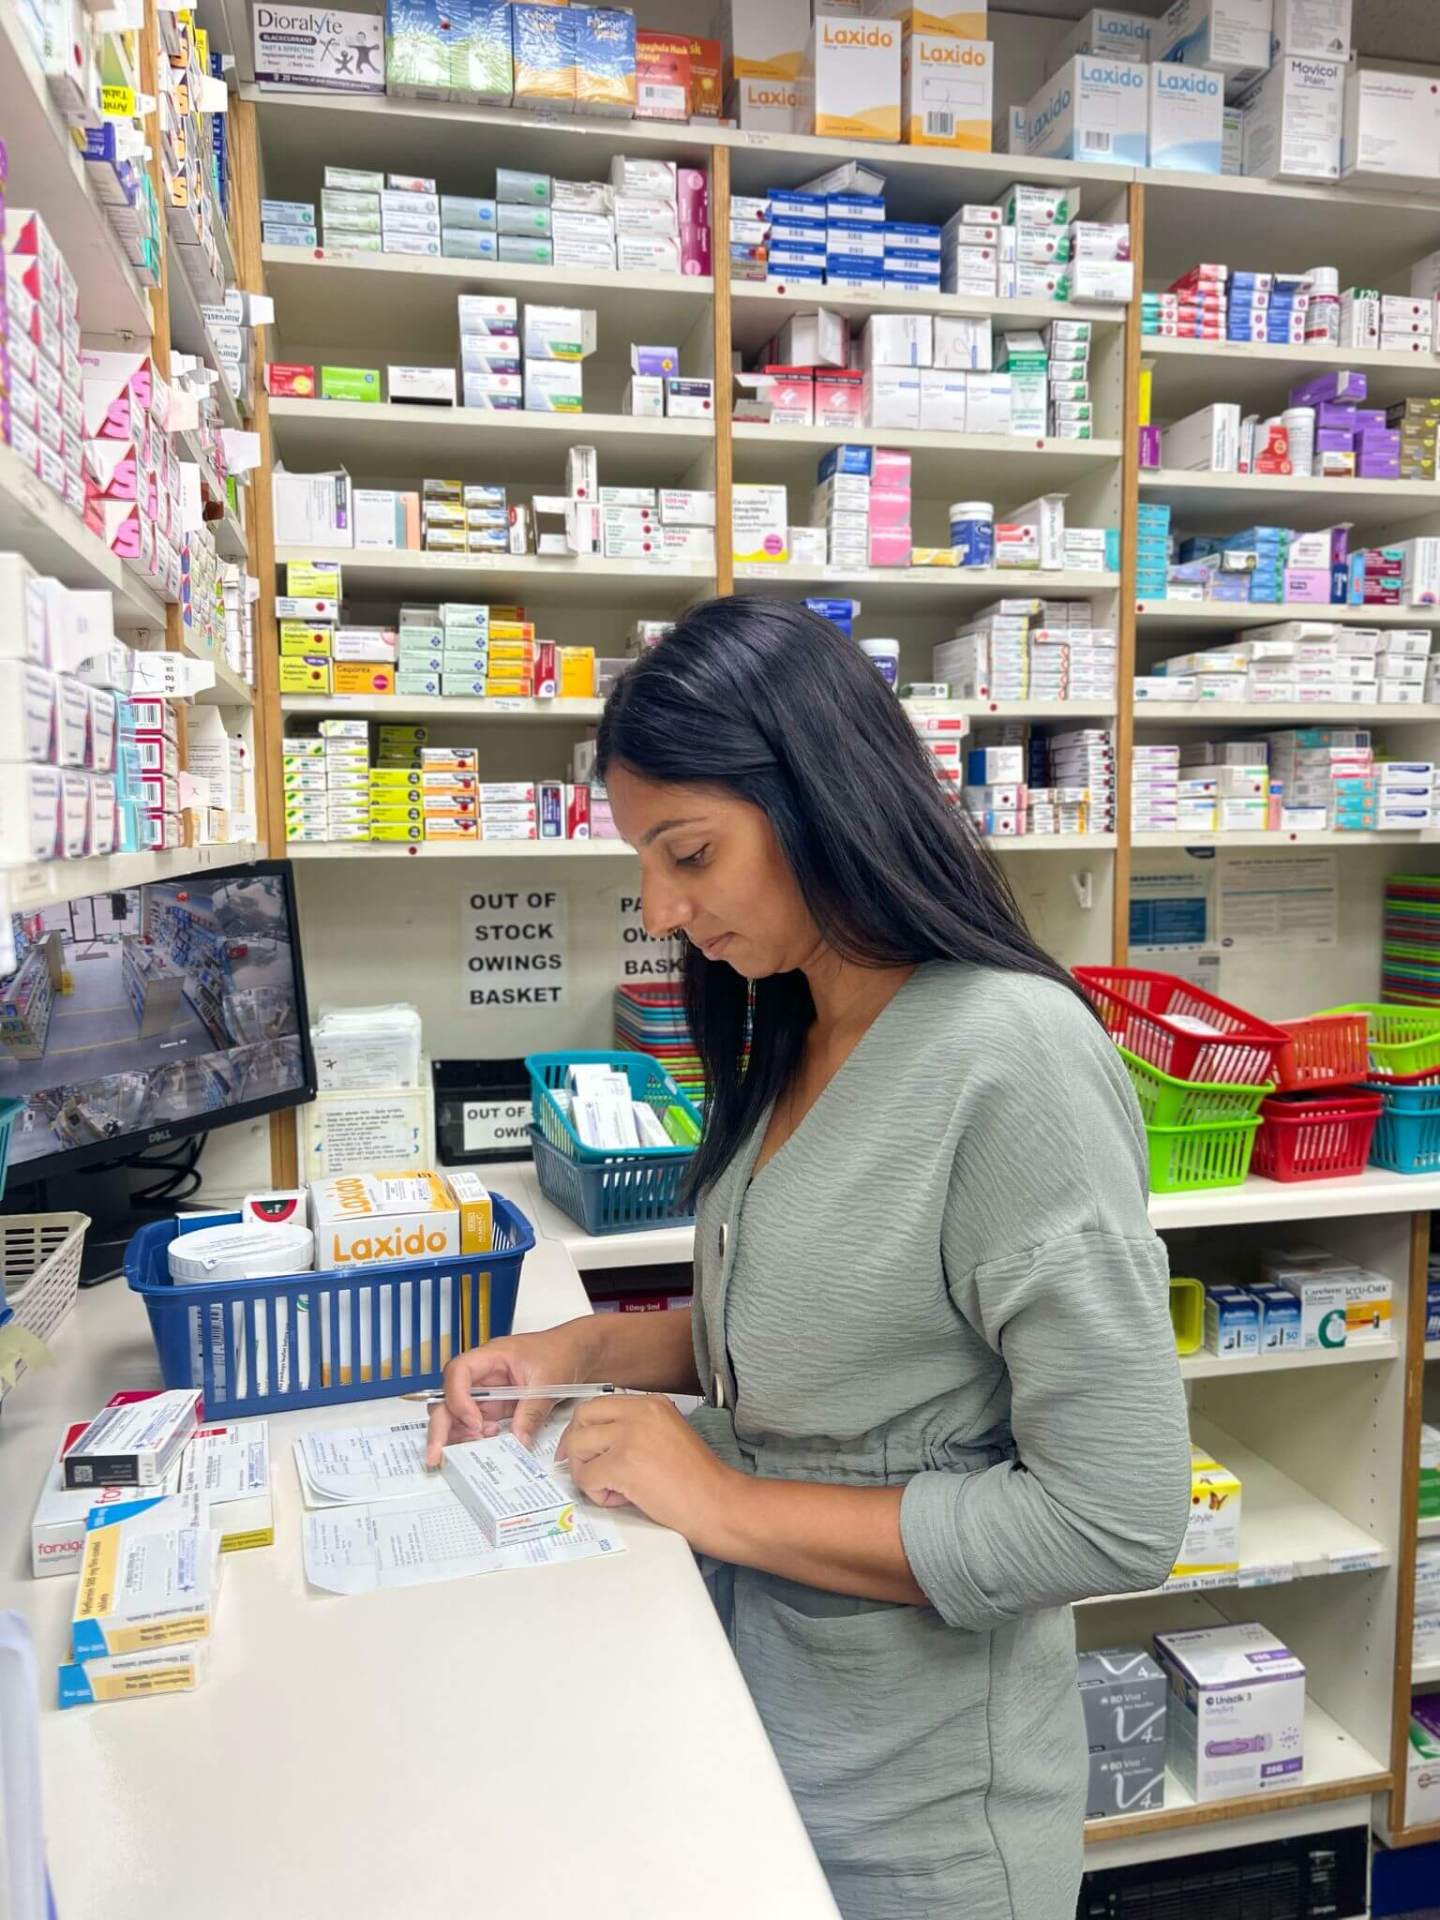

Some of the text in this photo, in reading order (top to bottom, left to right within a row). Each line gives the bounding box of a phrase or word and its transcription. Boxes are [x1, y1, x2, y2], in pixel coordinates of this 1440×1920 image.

[258, 8, 344, 34] Dioralyte
[824, 24, 893, 48] Laxido
[920, 42, 986, 66] Laxido
[1080, 58, 1144, 88] Laxido
[1291, 60, 1338, 78] Movicol
[1158, 70, 1218, 96] Laxido
[1303, 75, 1326, 86] Plain
[1026, 92, 1071, 142] Laxido
[1360, 290, 1379, 300] 120
[470, 892, 557, 910] OUT OF
[620, 898, 642, 913] PA
[475, 923, 554, 941] STOCK
[468, 954, 562, 972] OWINGS
[625, 958, 684, 975] BASK
[470, 986, 562, 1005] BASKET
[467, 1106, 526, 1120] OUT OF
[327, 1178, 372, 1216] Laxido
[334, 1224, 447, 1264] Laxido
[1244, 1334, 1256, 1343] 50
[1200, 1578, 1213, 1587] Test
[1110, 1692, 1142, 1704] BD Viva
[1215, 1694, 1244, 1706] Unistik
[1110, 1760, 1141, 1770] BD Viva
